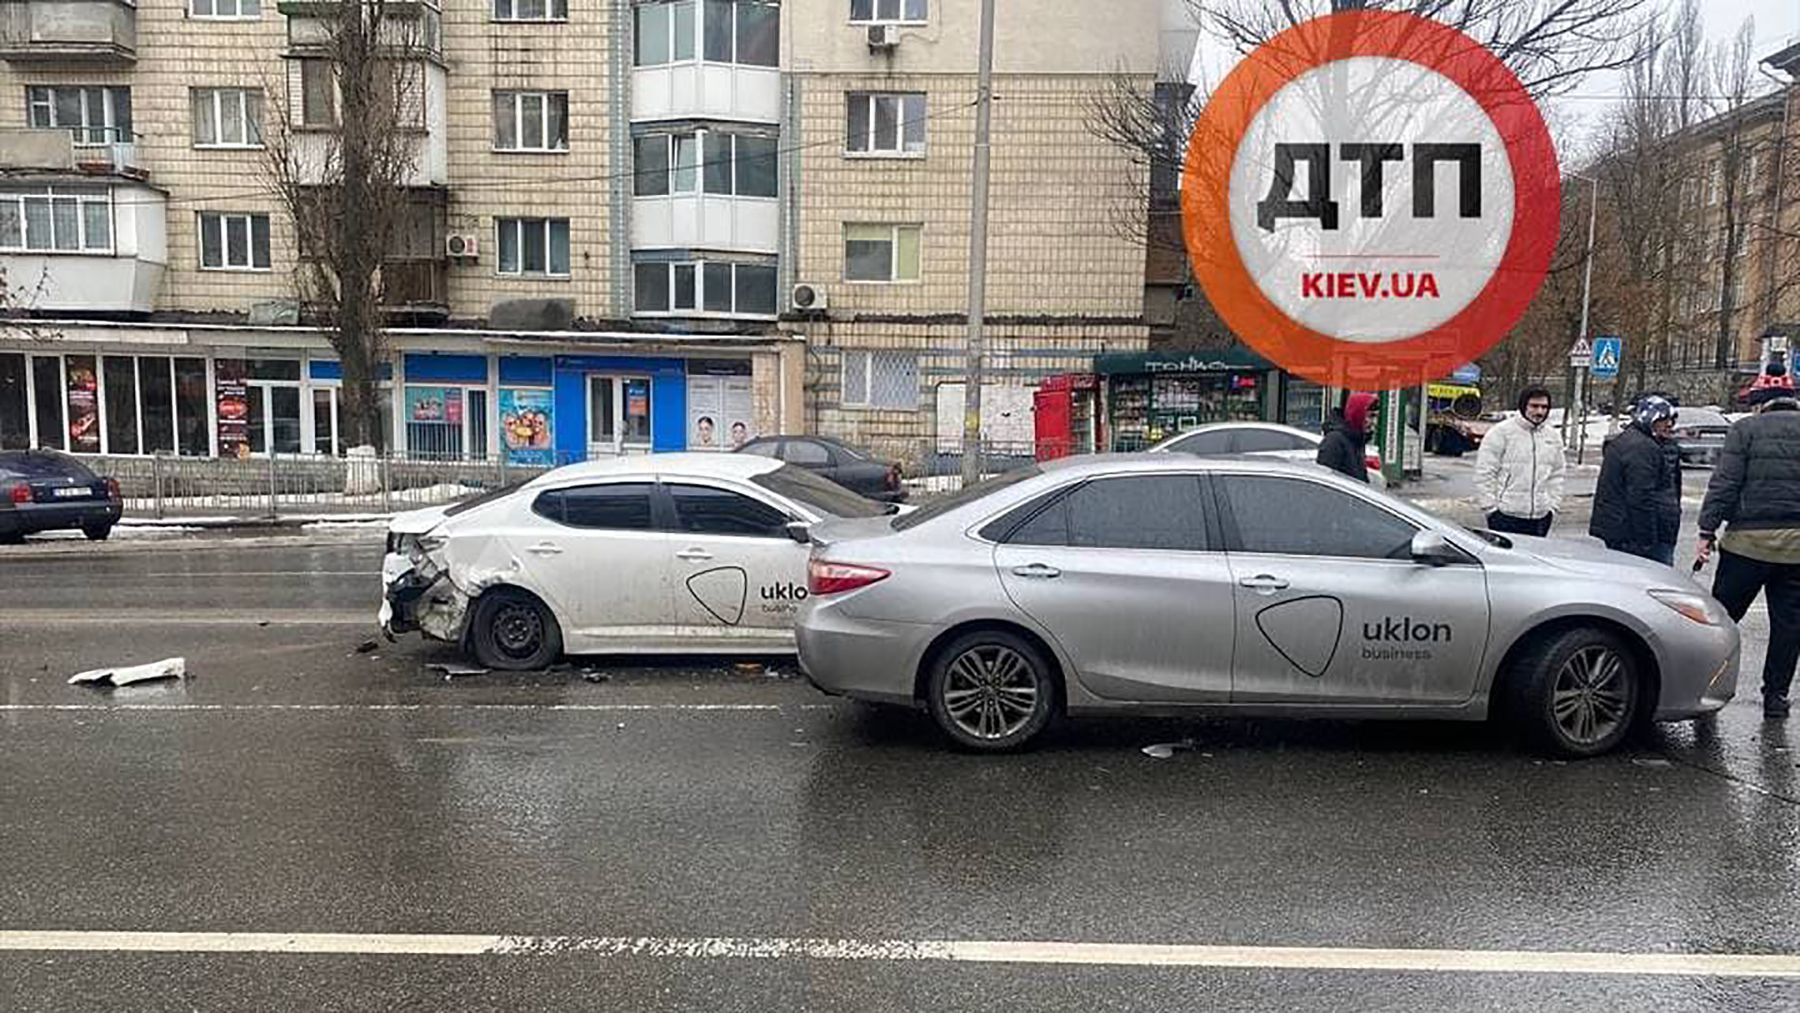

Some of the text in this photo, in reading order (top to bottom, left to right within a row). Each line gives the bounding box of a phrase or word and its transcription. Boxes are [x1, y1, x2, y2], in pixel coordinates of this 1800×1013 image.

[761, 582, 808, 600] uklo
[1363, 617, 1452, 642] uklon
[1362, 647, 1433, 660] business
